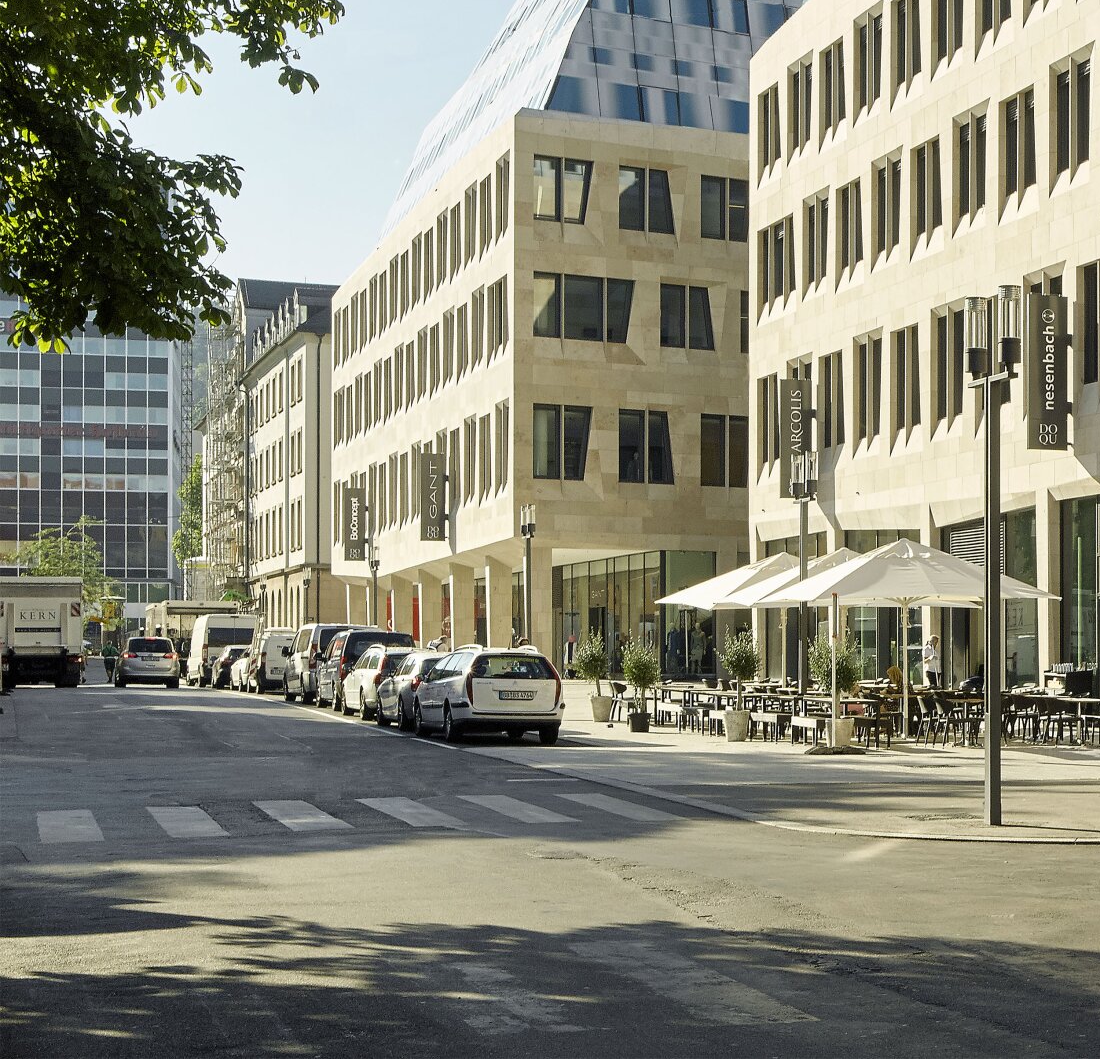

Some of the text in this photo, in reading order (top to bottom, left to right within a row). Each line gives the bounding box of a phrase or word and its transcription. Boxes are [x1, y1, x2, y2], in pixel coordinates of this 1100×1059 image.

[1042, 326, 1054, 410] nesenbach
[791, 390, 803, 453] ARCOLIS
[429, 461, 437, 518] GANT
[350, 497, 359, 540] BoConcept
[20, 611, 56, 620] KERN
